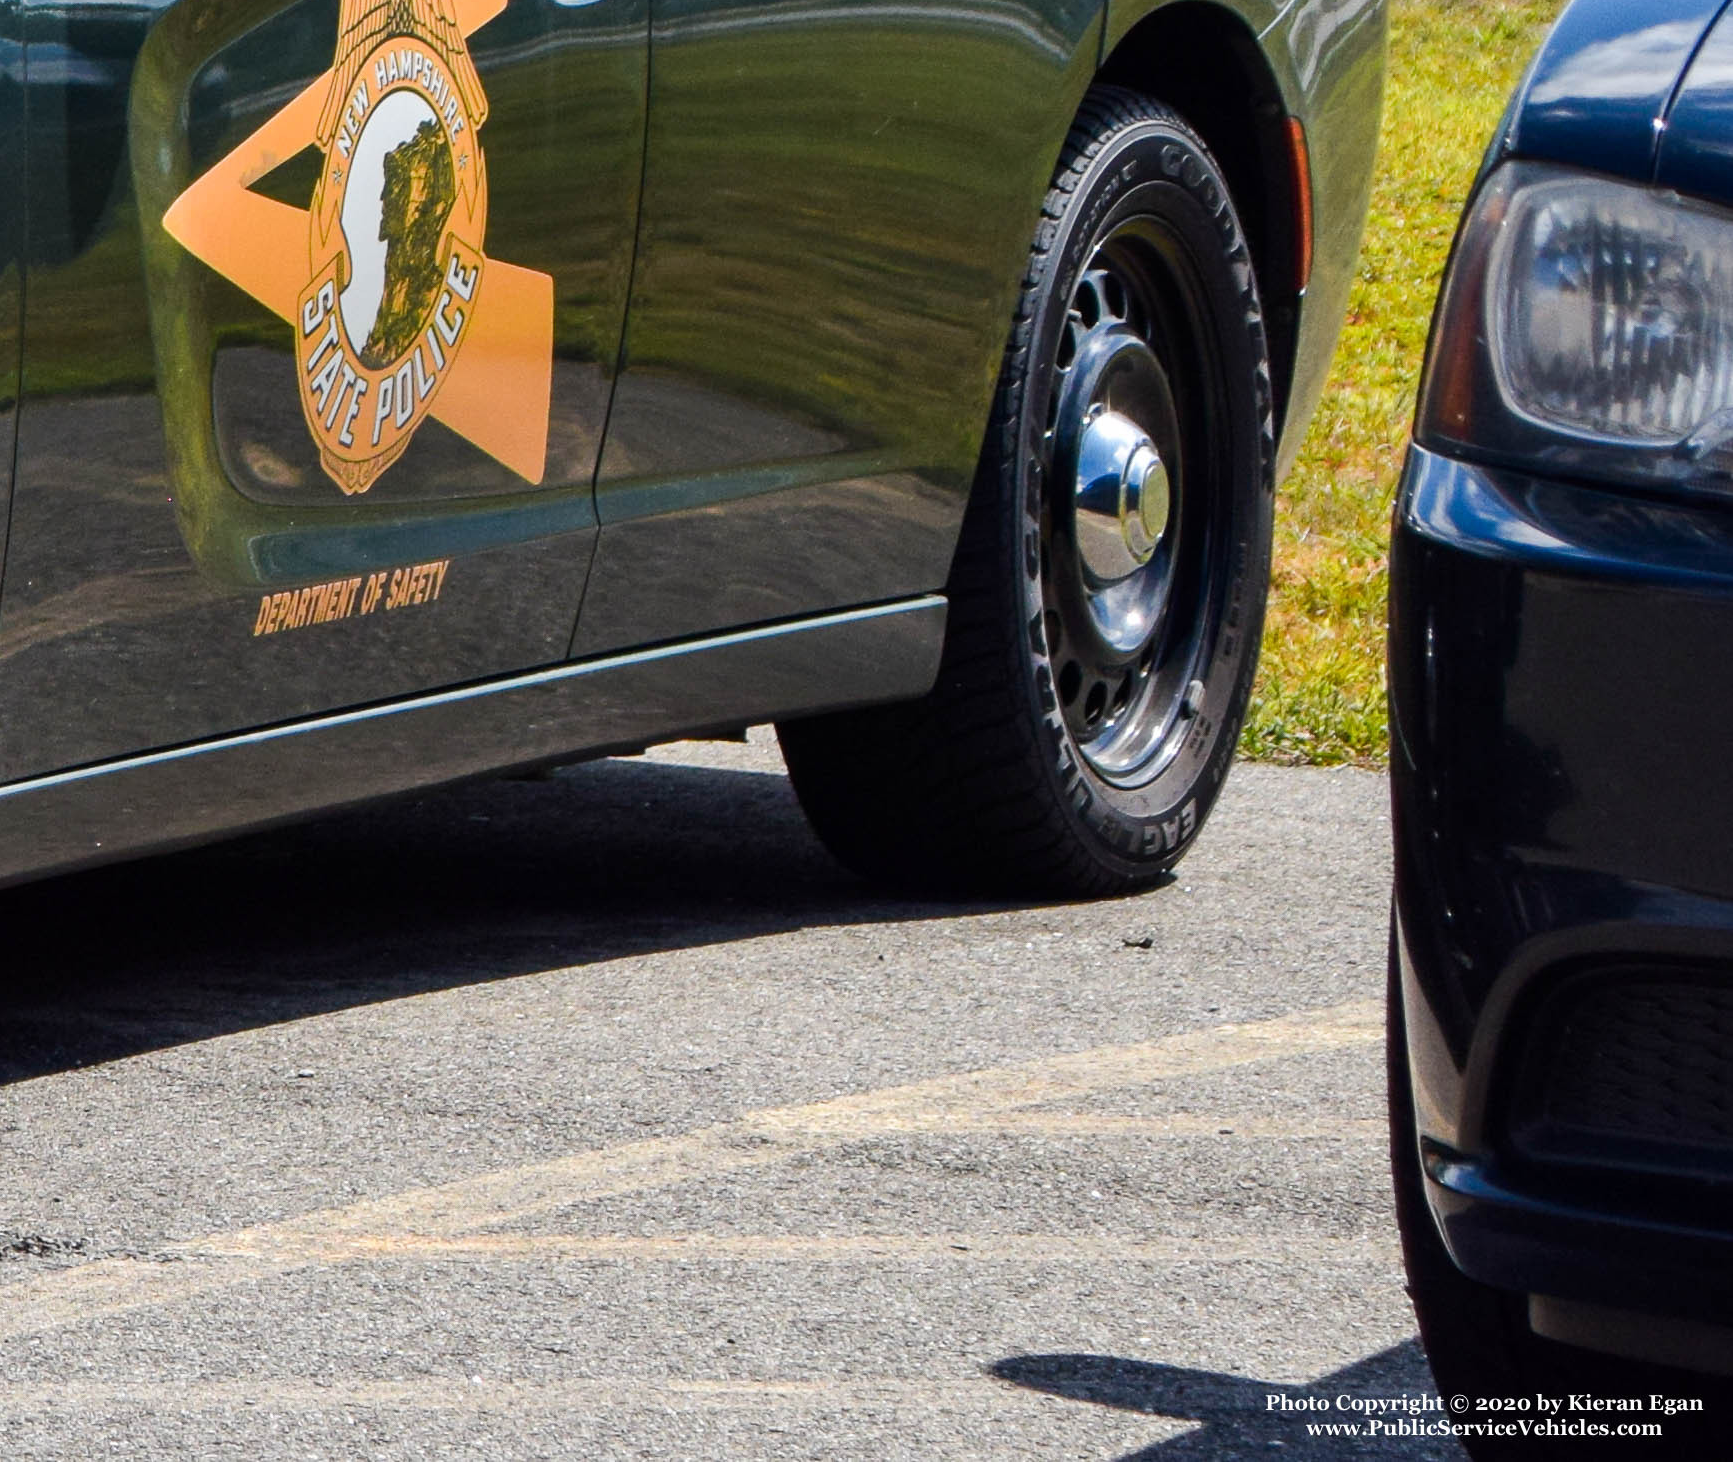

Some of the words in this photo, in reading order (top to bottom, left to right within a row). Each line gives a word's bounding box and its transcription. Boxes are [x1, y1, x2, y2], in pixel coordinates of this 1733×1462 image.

[337, 79, 371, 159] NEW
[374, 49, 466, 146] HAMPSHIRE
[303, 279, 369, 448] STATE
[371, 252, 480, 447] POLICE
[253, 577, 362, 637] DEPARTMENT
[361, 572, 387, 615] OF
[386, 559, 450, 610] SAFETY
